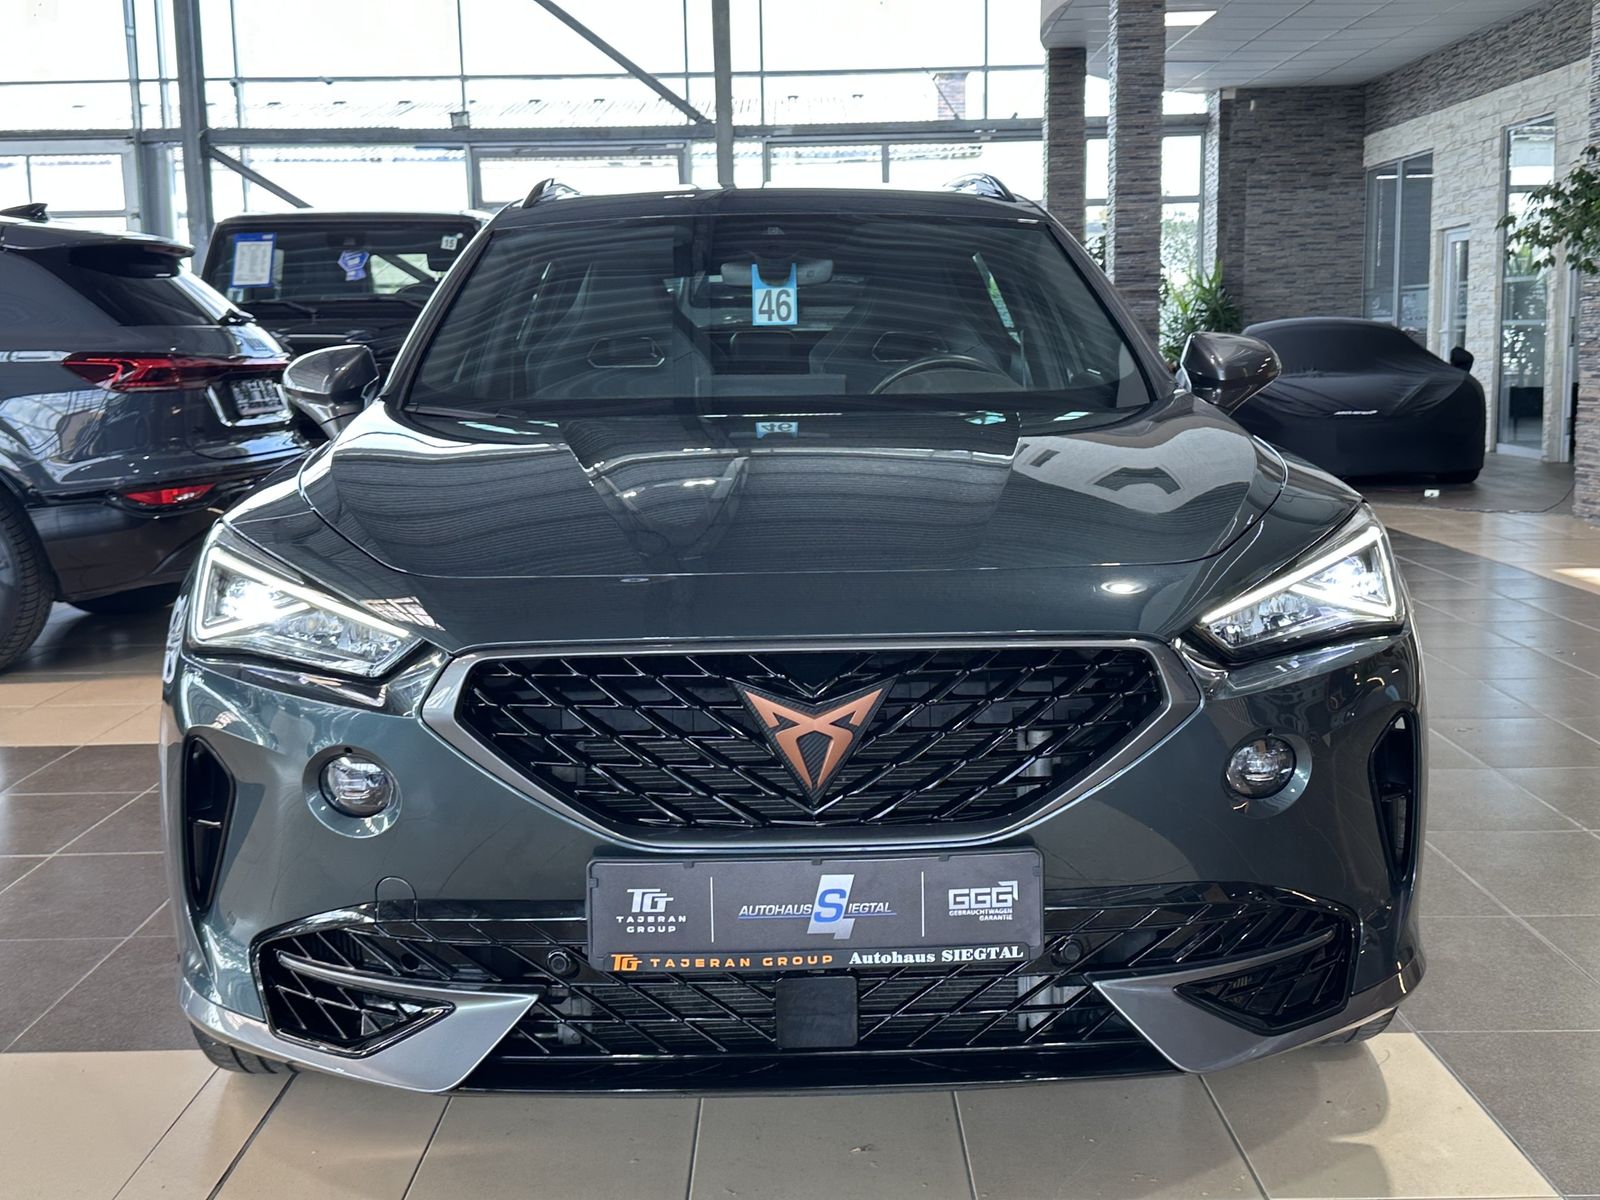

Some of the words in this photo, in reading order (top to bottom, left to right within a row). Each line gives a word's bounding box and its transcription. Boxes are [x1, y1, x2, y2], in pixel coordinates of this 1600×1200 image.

[758, 289, 792, 322] 46
[949, 886, 1013, 910] GGG
[738, 903, 813, 916] AUTOHAUS
[948, 908, 1013, 917] GEBRAUCHTWAGEN
[616, 915, 687, 924] TAJERAN
[626, 925, 677, 934] GROUP
[650, 957, 751, 968] TAJERAN
[762, 955, 833, 967] GROUP
[849, 951, 935, 965] Autohaus
[941, 945, 1024, 962] SIEGTAL
